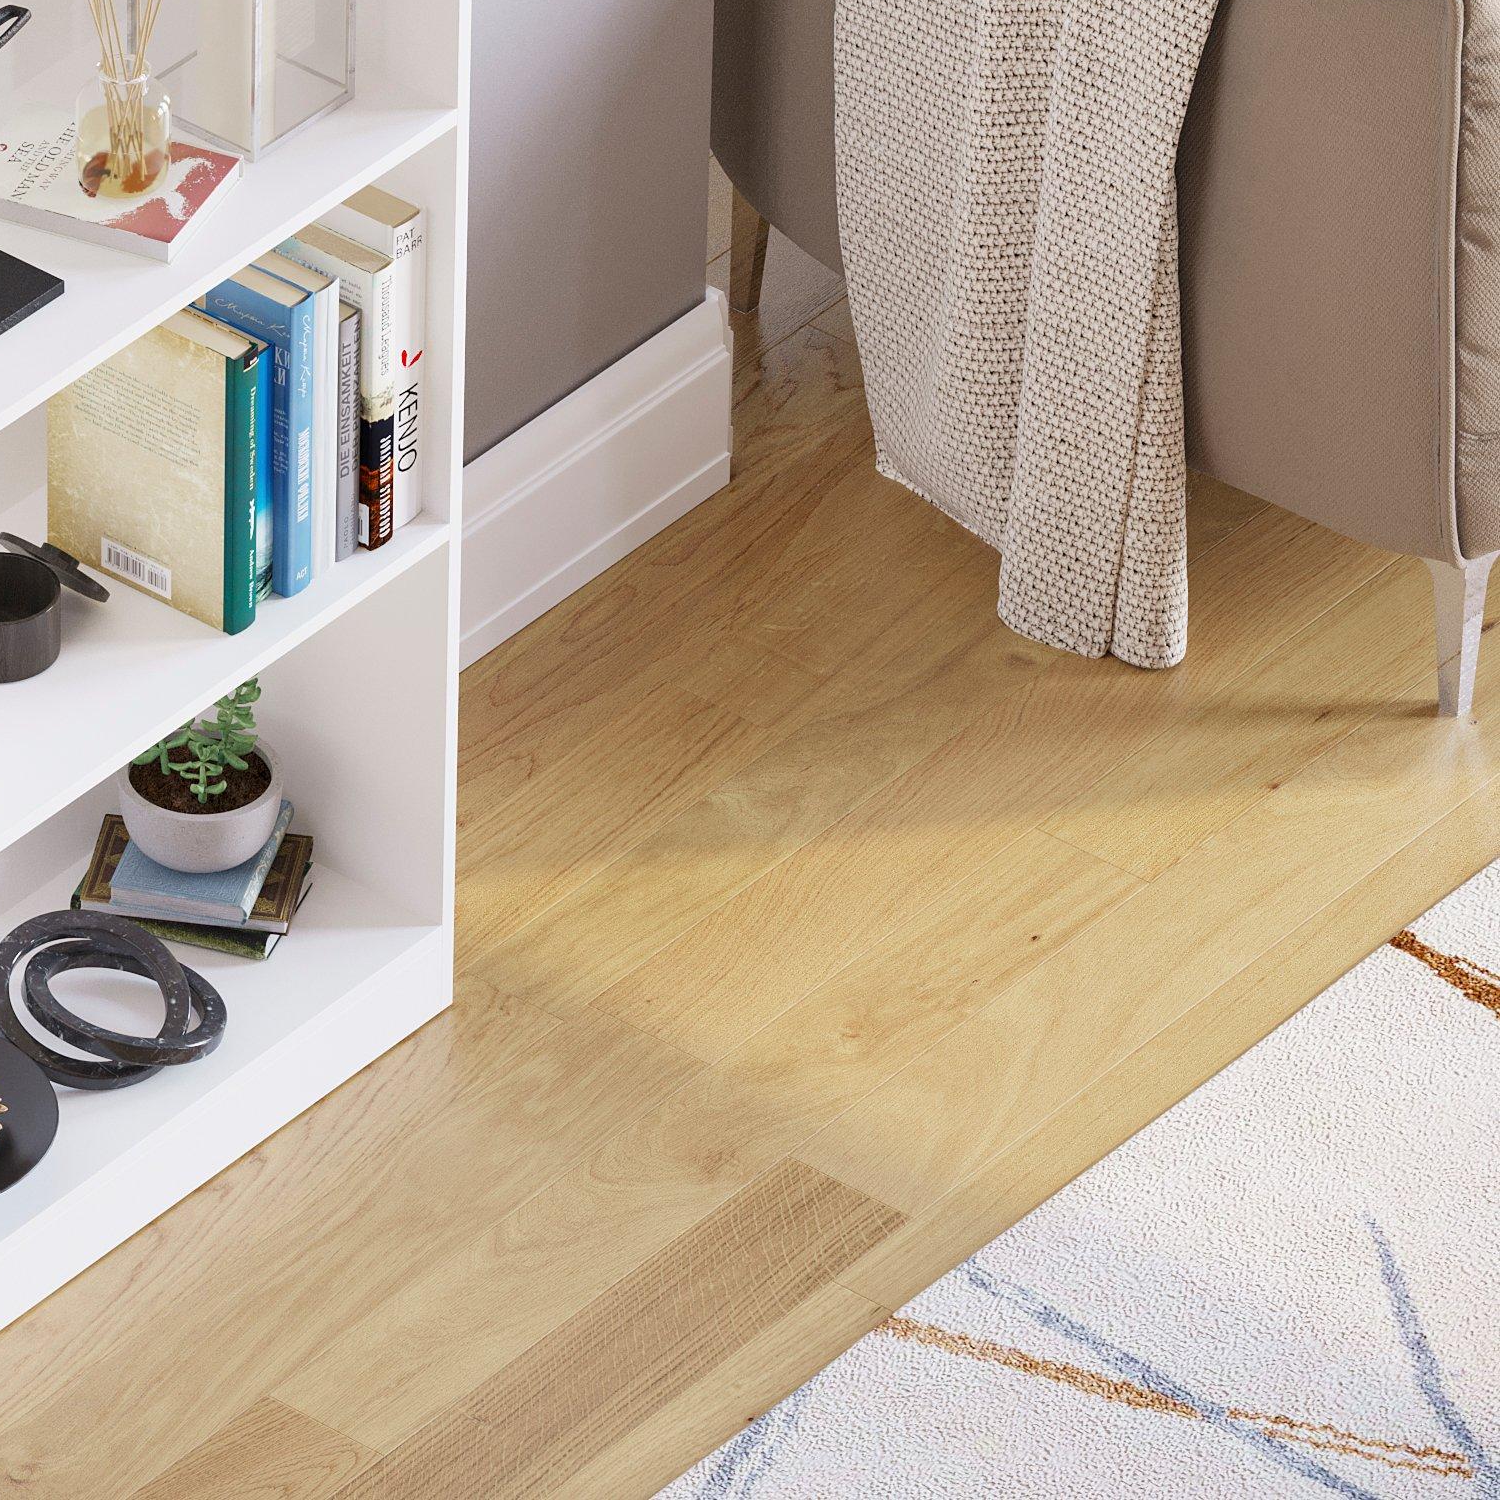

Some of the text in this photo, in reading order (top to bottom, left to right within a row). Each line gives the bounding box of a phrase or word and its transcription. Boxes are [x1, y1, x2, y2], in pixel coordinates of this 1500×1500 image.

[7, 141, 35, 163] SEA
[35, 146, 62, 172] OLD
[10, 173, 41, 199] MAN
[396, 227, 416, 246] PAT
[396, 235, 423, 260] BARR
[340, 342, 351, 479] DIE EINSAMKEIT
[398, 382, 419, 472] KENJO
[380, 434, 392, 485] JONATHAN
